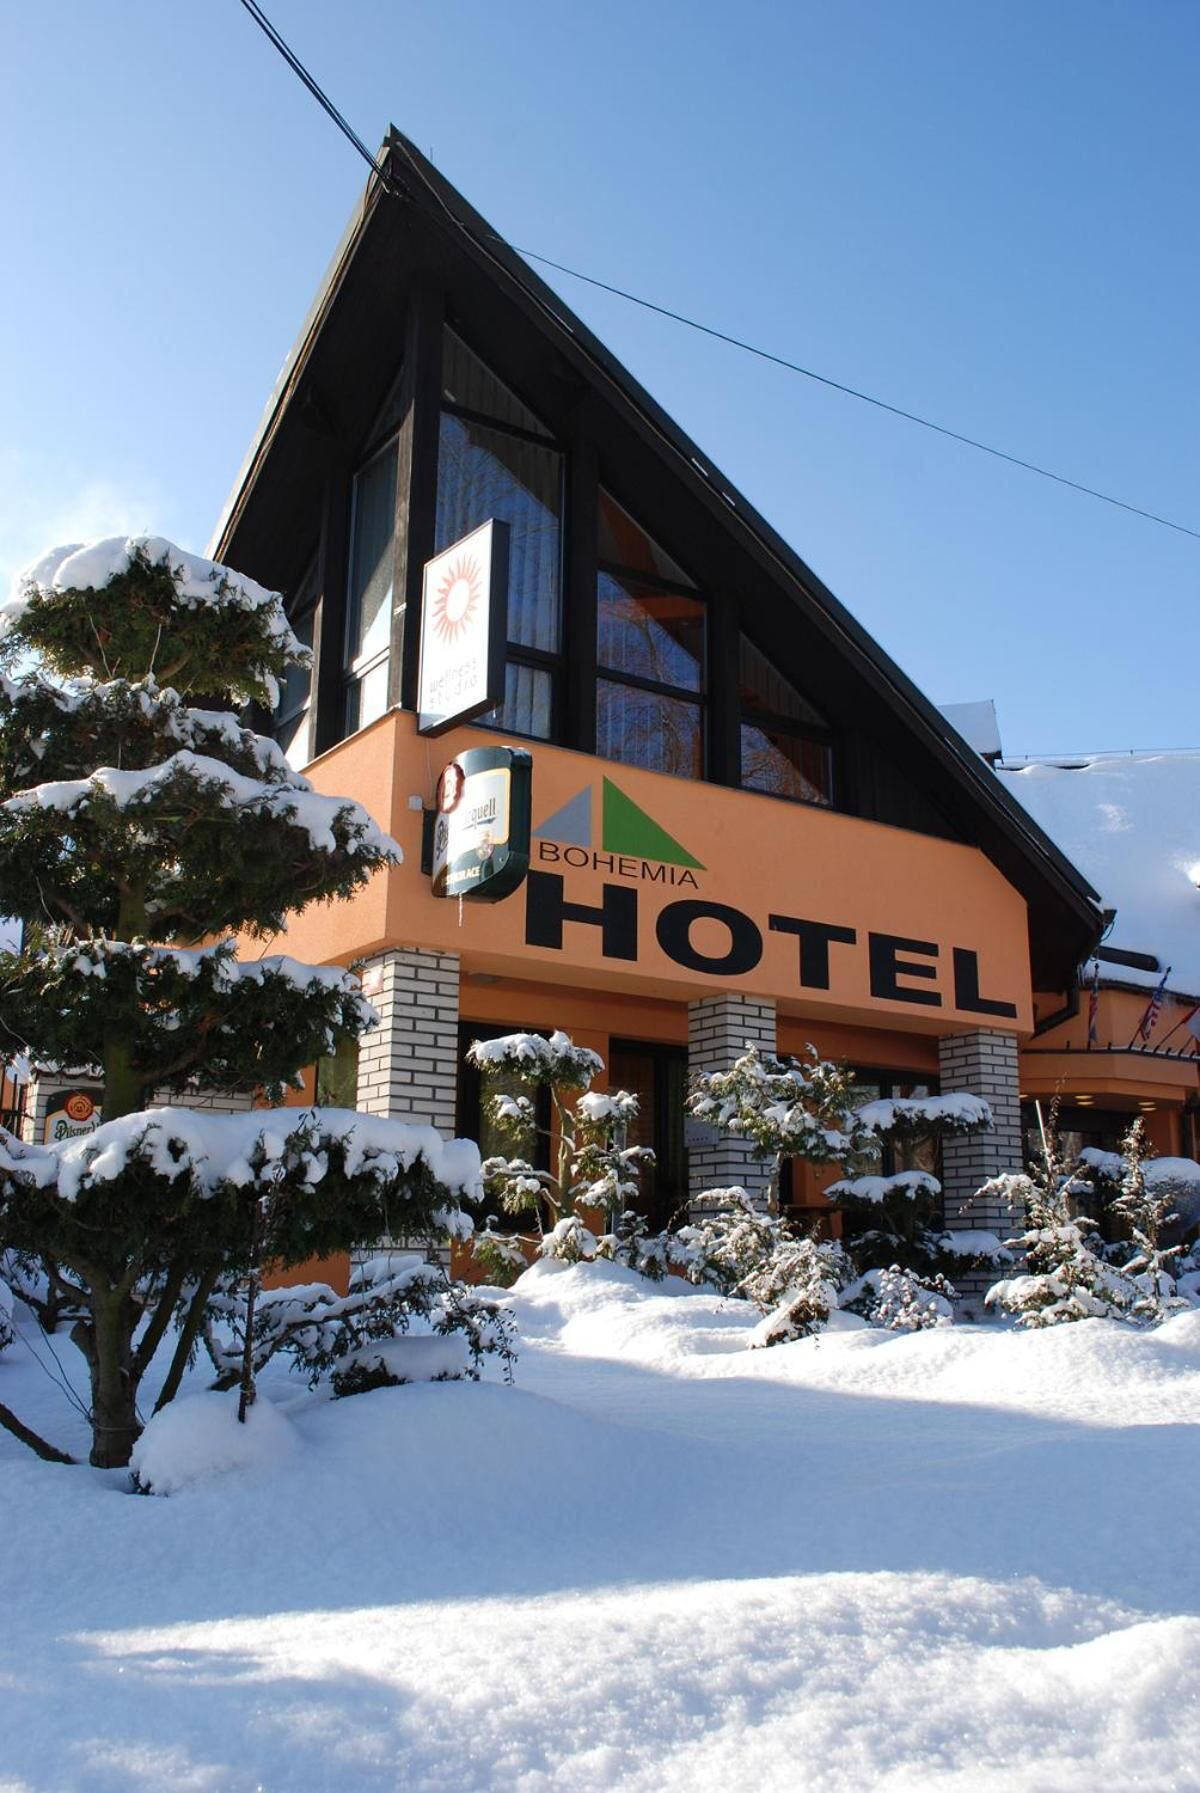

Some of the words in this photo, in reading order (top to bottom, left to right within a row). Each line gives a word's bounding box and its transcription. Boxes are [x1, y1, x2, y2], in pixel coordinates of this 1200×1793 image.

[539, 841, 699, 890] BOHEMIA
[525, 869, 1017, 1019] HOTEL
[54, 1119, 92, 1141] Pilsner
